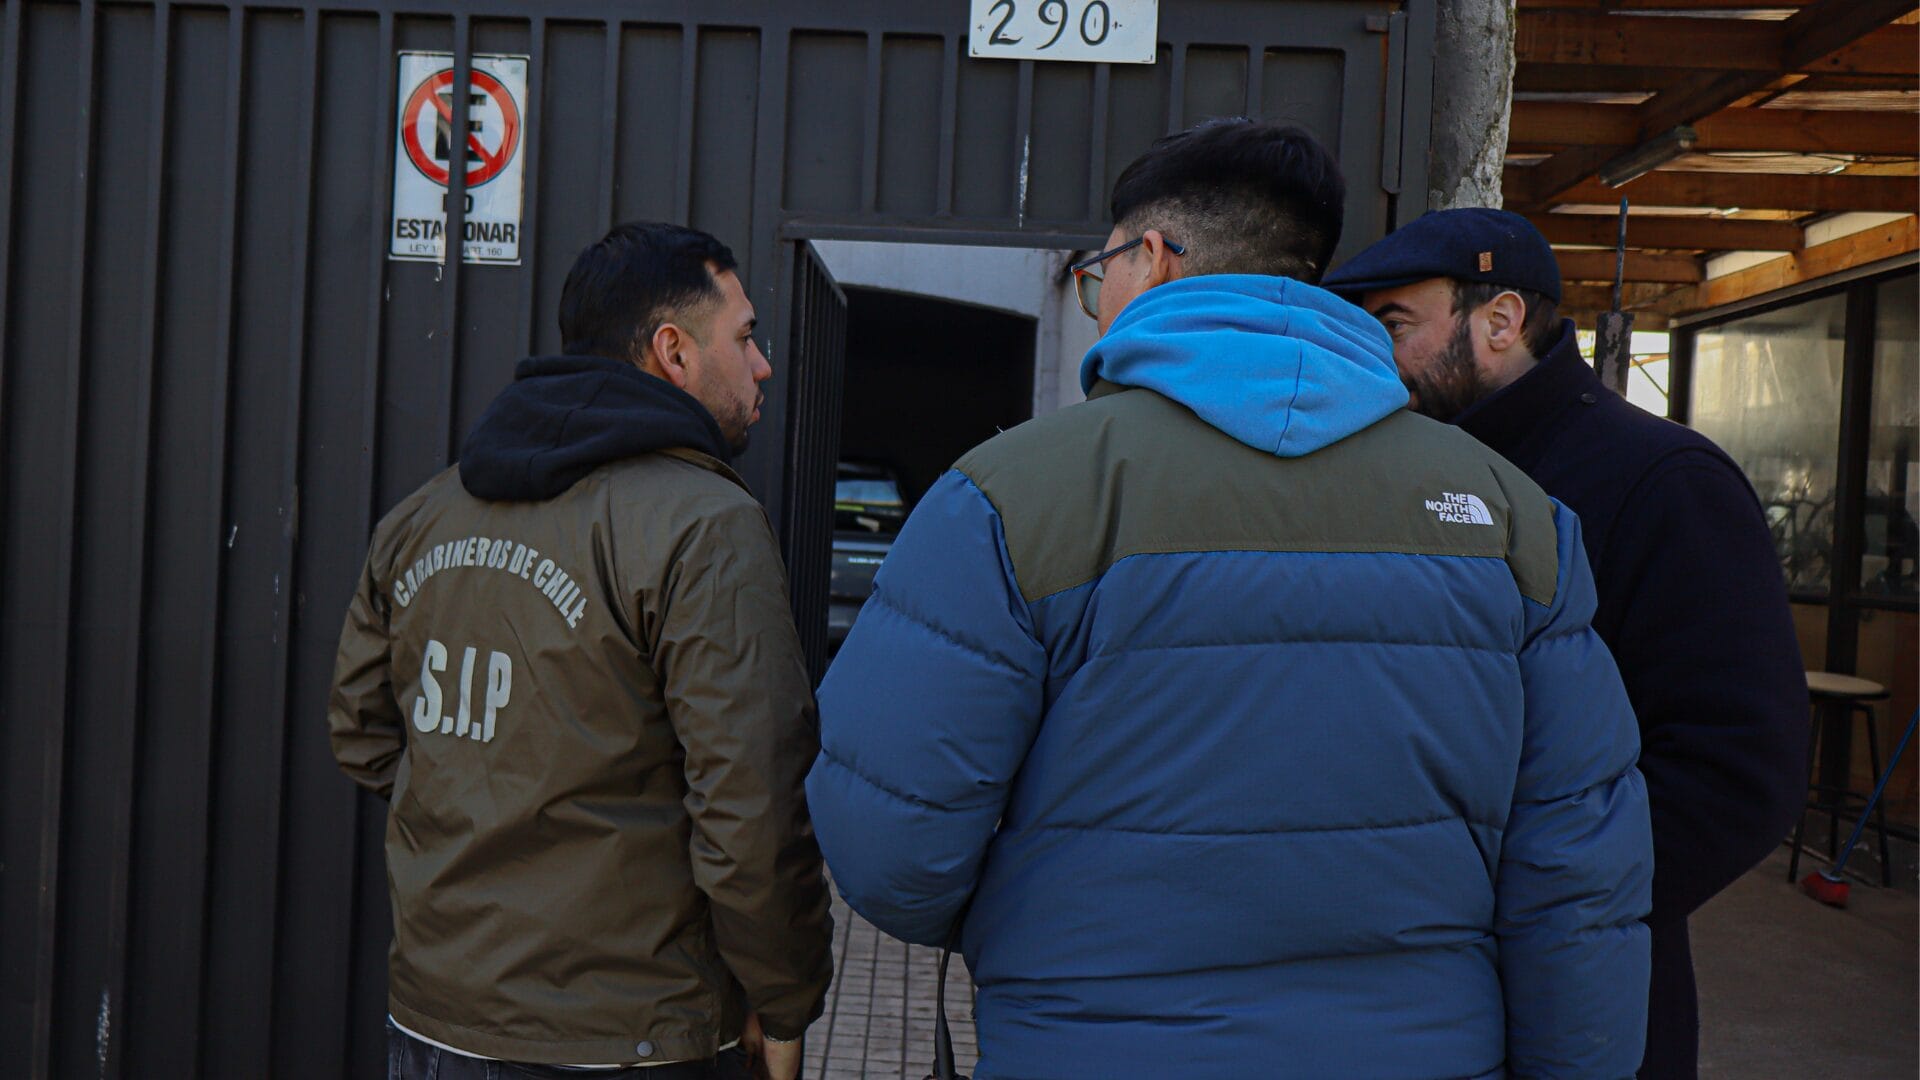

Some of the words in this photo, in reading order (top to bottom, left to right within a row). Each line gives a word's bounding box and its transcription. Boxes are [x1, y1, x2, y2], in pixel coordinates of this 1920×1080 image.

[987, 0, 1110, 50] 290
[396, 218, 516, 243] ESTAONAR
[409, 243, 429, 253] LEY
[487, 247, 503, 256] 160
[1425, 499, 1469, 513] NORTH
[1442, 492, 1468, 504] THE
[1439, 512, 1472, 524] FACE
[393, 537, 513, 608] CARABINEROS
[507, 543, 539, 580] DE
[533, 558, 588, 629] CHILE
[413, 639, 512, 743] S.I.P
